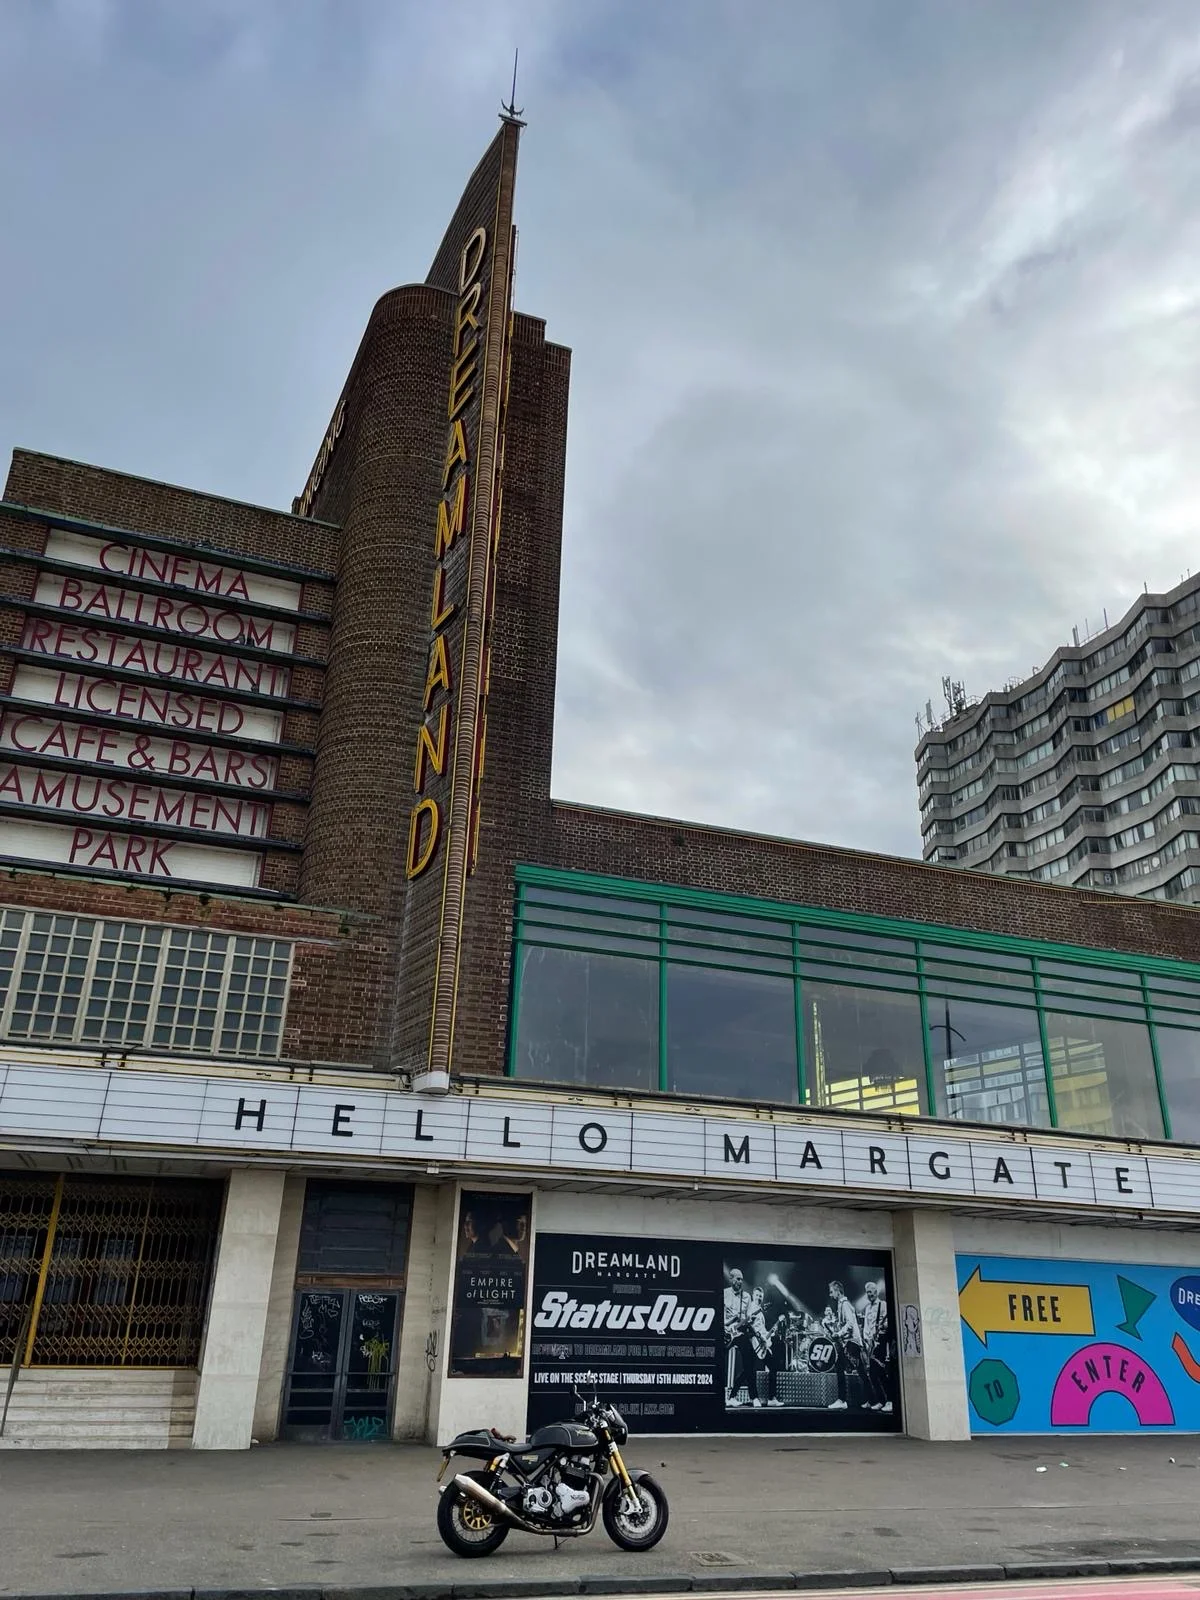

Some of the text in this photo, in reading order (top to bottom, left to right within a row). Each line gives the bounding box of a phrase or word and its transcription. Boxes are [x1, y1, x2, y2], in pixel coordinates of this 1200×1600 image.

[99, 541, 251, 601] CINEMA
[406, 226, 486, 880] DREAMLAND
[59, 577, 274, 650] BALLROOM
[28, 620, 284, 697] RESTAURANT
[53, 672, 244, 735] LICENSED
[10, 715, 269, 790] CAFE & BARS
[0, 765, 265, 837] AMUSEMENT
[68, 827, 177, 877] PARK
[234, 1096, 1134, 1195] HELLO MARGATE
[470, 1277, 513, 1288] EMPIRE
[572, 1251, 681, 1278] DREAMLAND
[479, 1290, 516, 1300] LIGHT
[1008, 1294, 1062, 1323] FREE
[534, 1372, 550, 1384] LIVE
[550, 1372, 560, 1384] ON
[561, 1372, 574, 1384] THE
[599, 1373, 619, 1385] STAGE
[623, 1373, 656, 1385] THURSDAY
[656, 1374, 672, 1385] 15TH
[672, 1374, 697, 1385] AUGUST
[697, 1374, 713, 1385] 2024
[810, 1344, 834, 1363] SQ
[1071, 1355, 1146, 1393] ENTER
[984, 1378, 1004, 1402] TO
